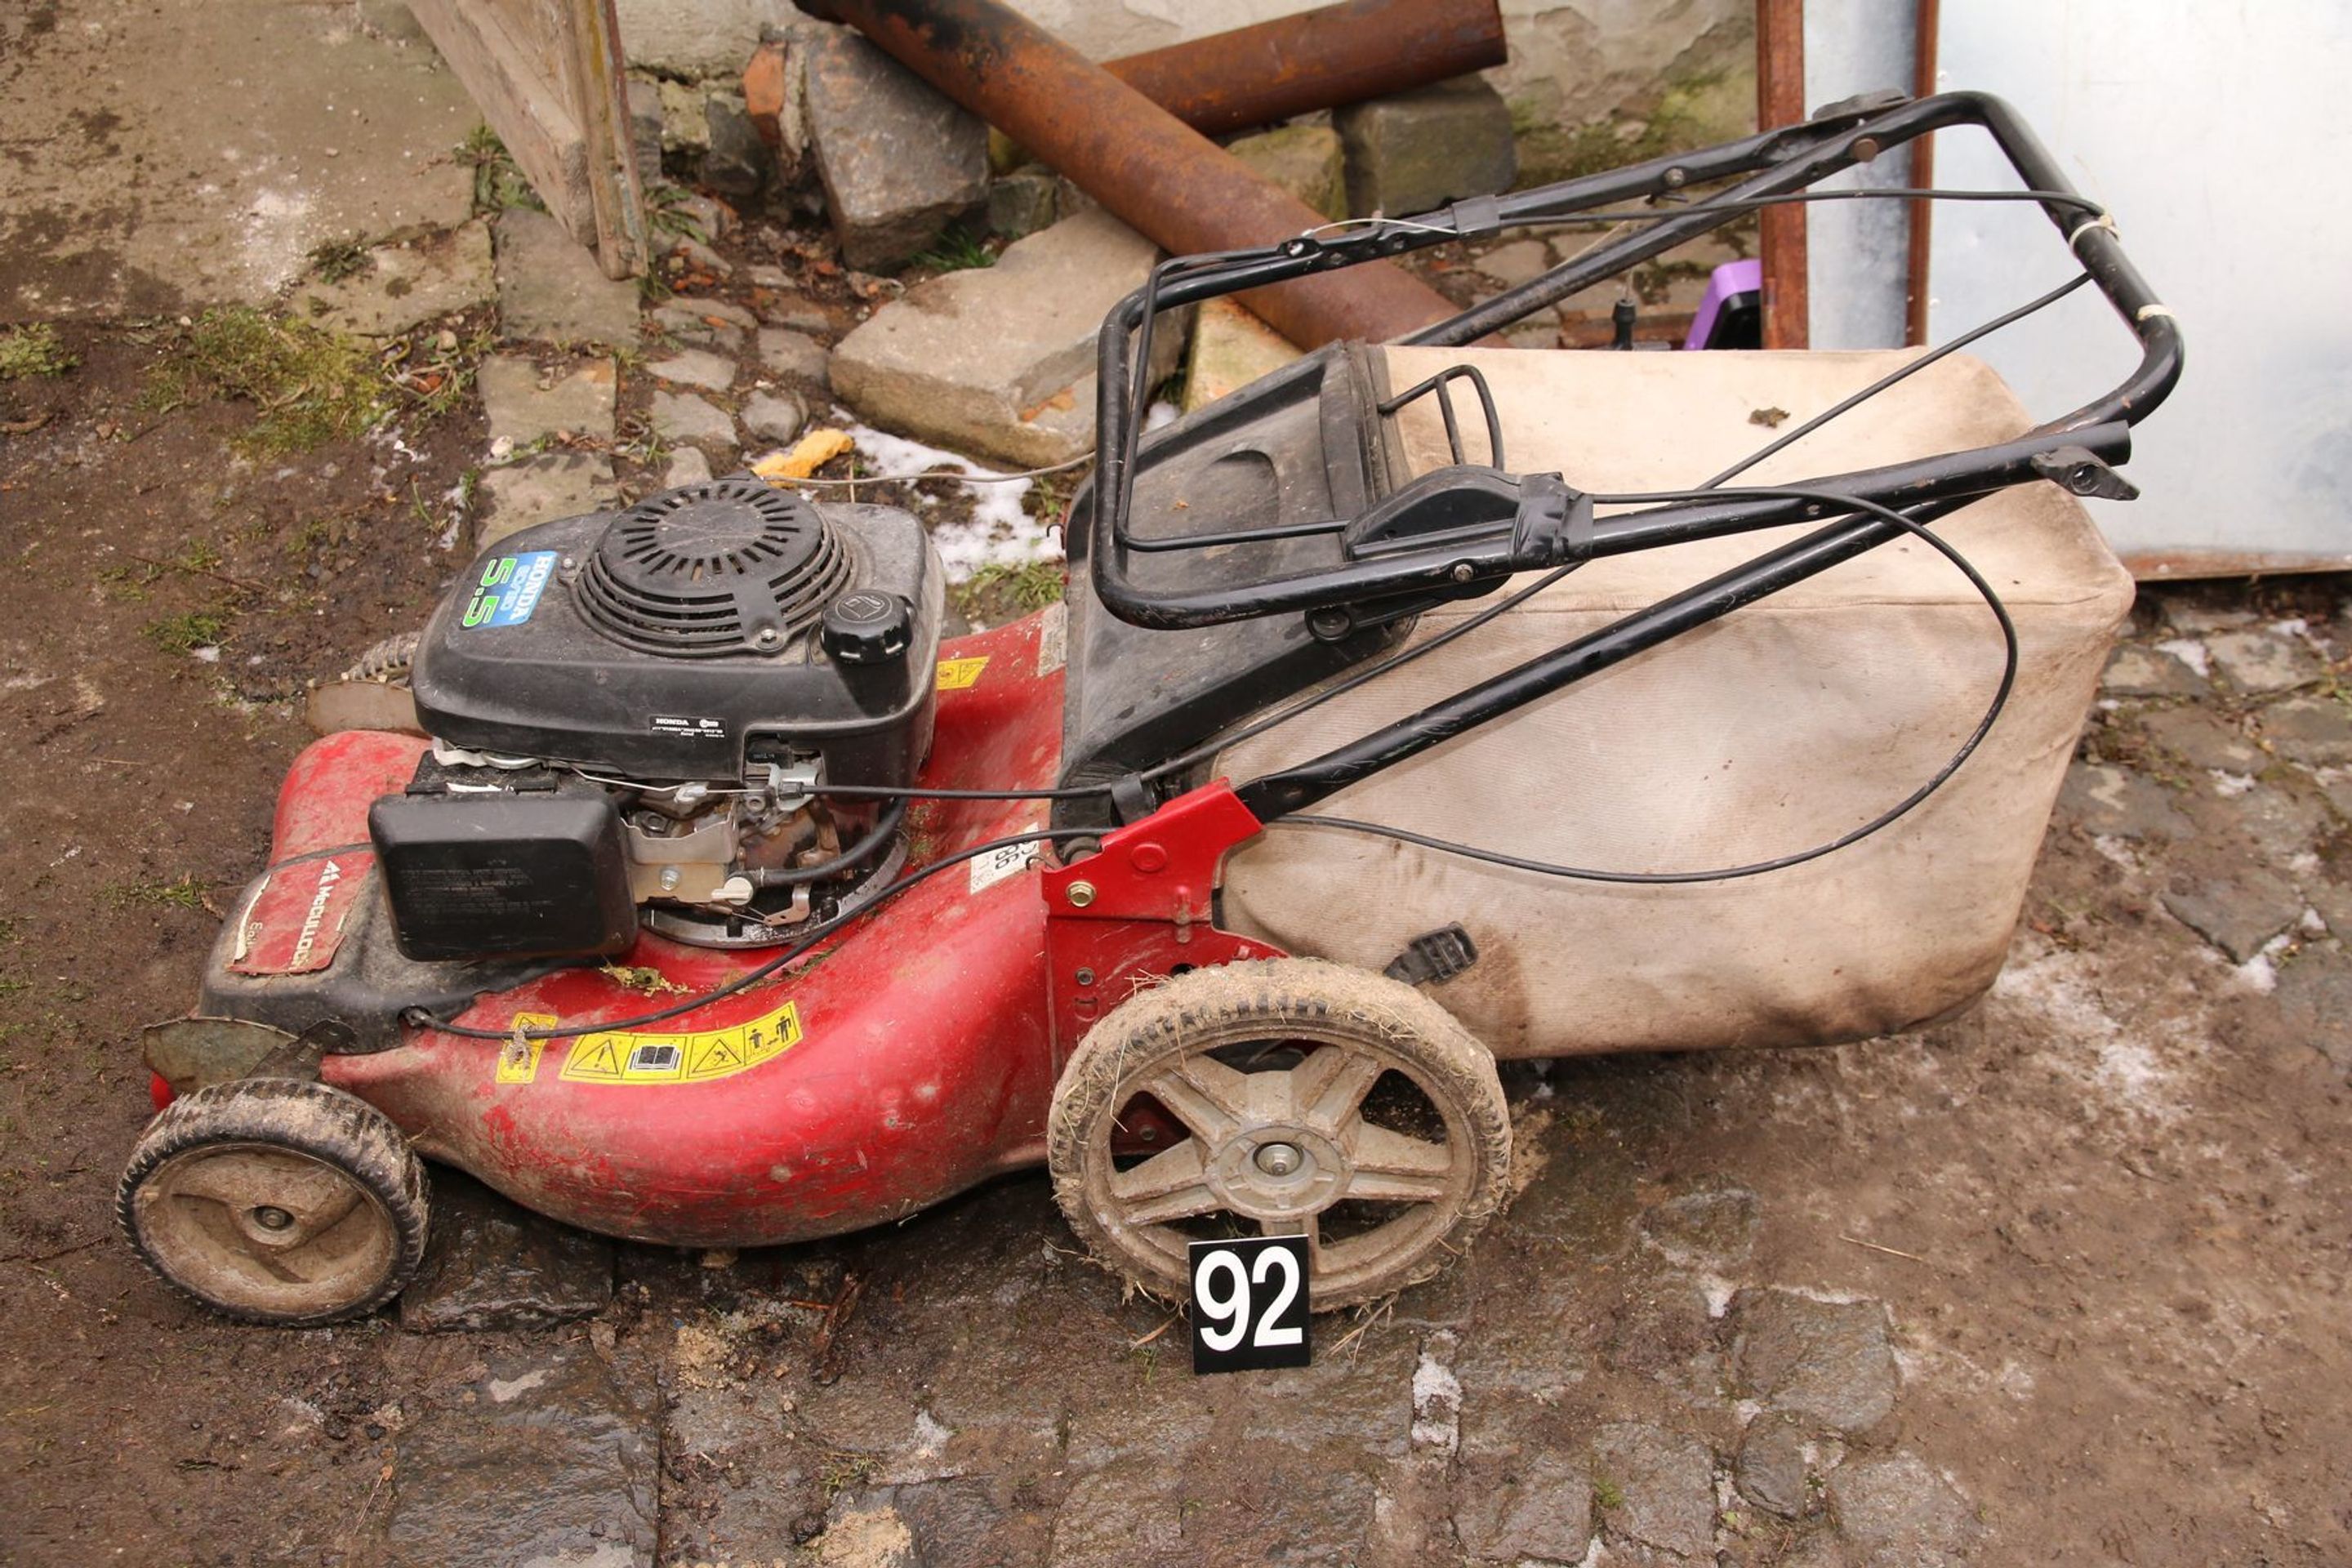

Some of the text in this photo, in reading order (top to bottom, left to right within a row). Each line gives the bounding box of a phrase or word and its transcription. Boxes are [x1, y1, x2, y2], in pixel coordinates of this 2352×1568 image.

[462, 557, 517, 627] 5.5
[510, 555, 554, 621] HONDA
[656, 718, 689, 726] HONDA
[1195, 1245, 1303, 1352] 92
